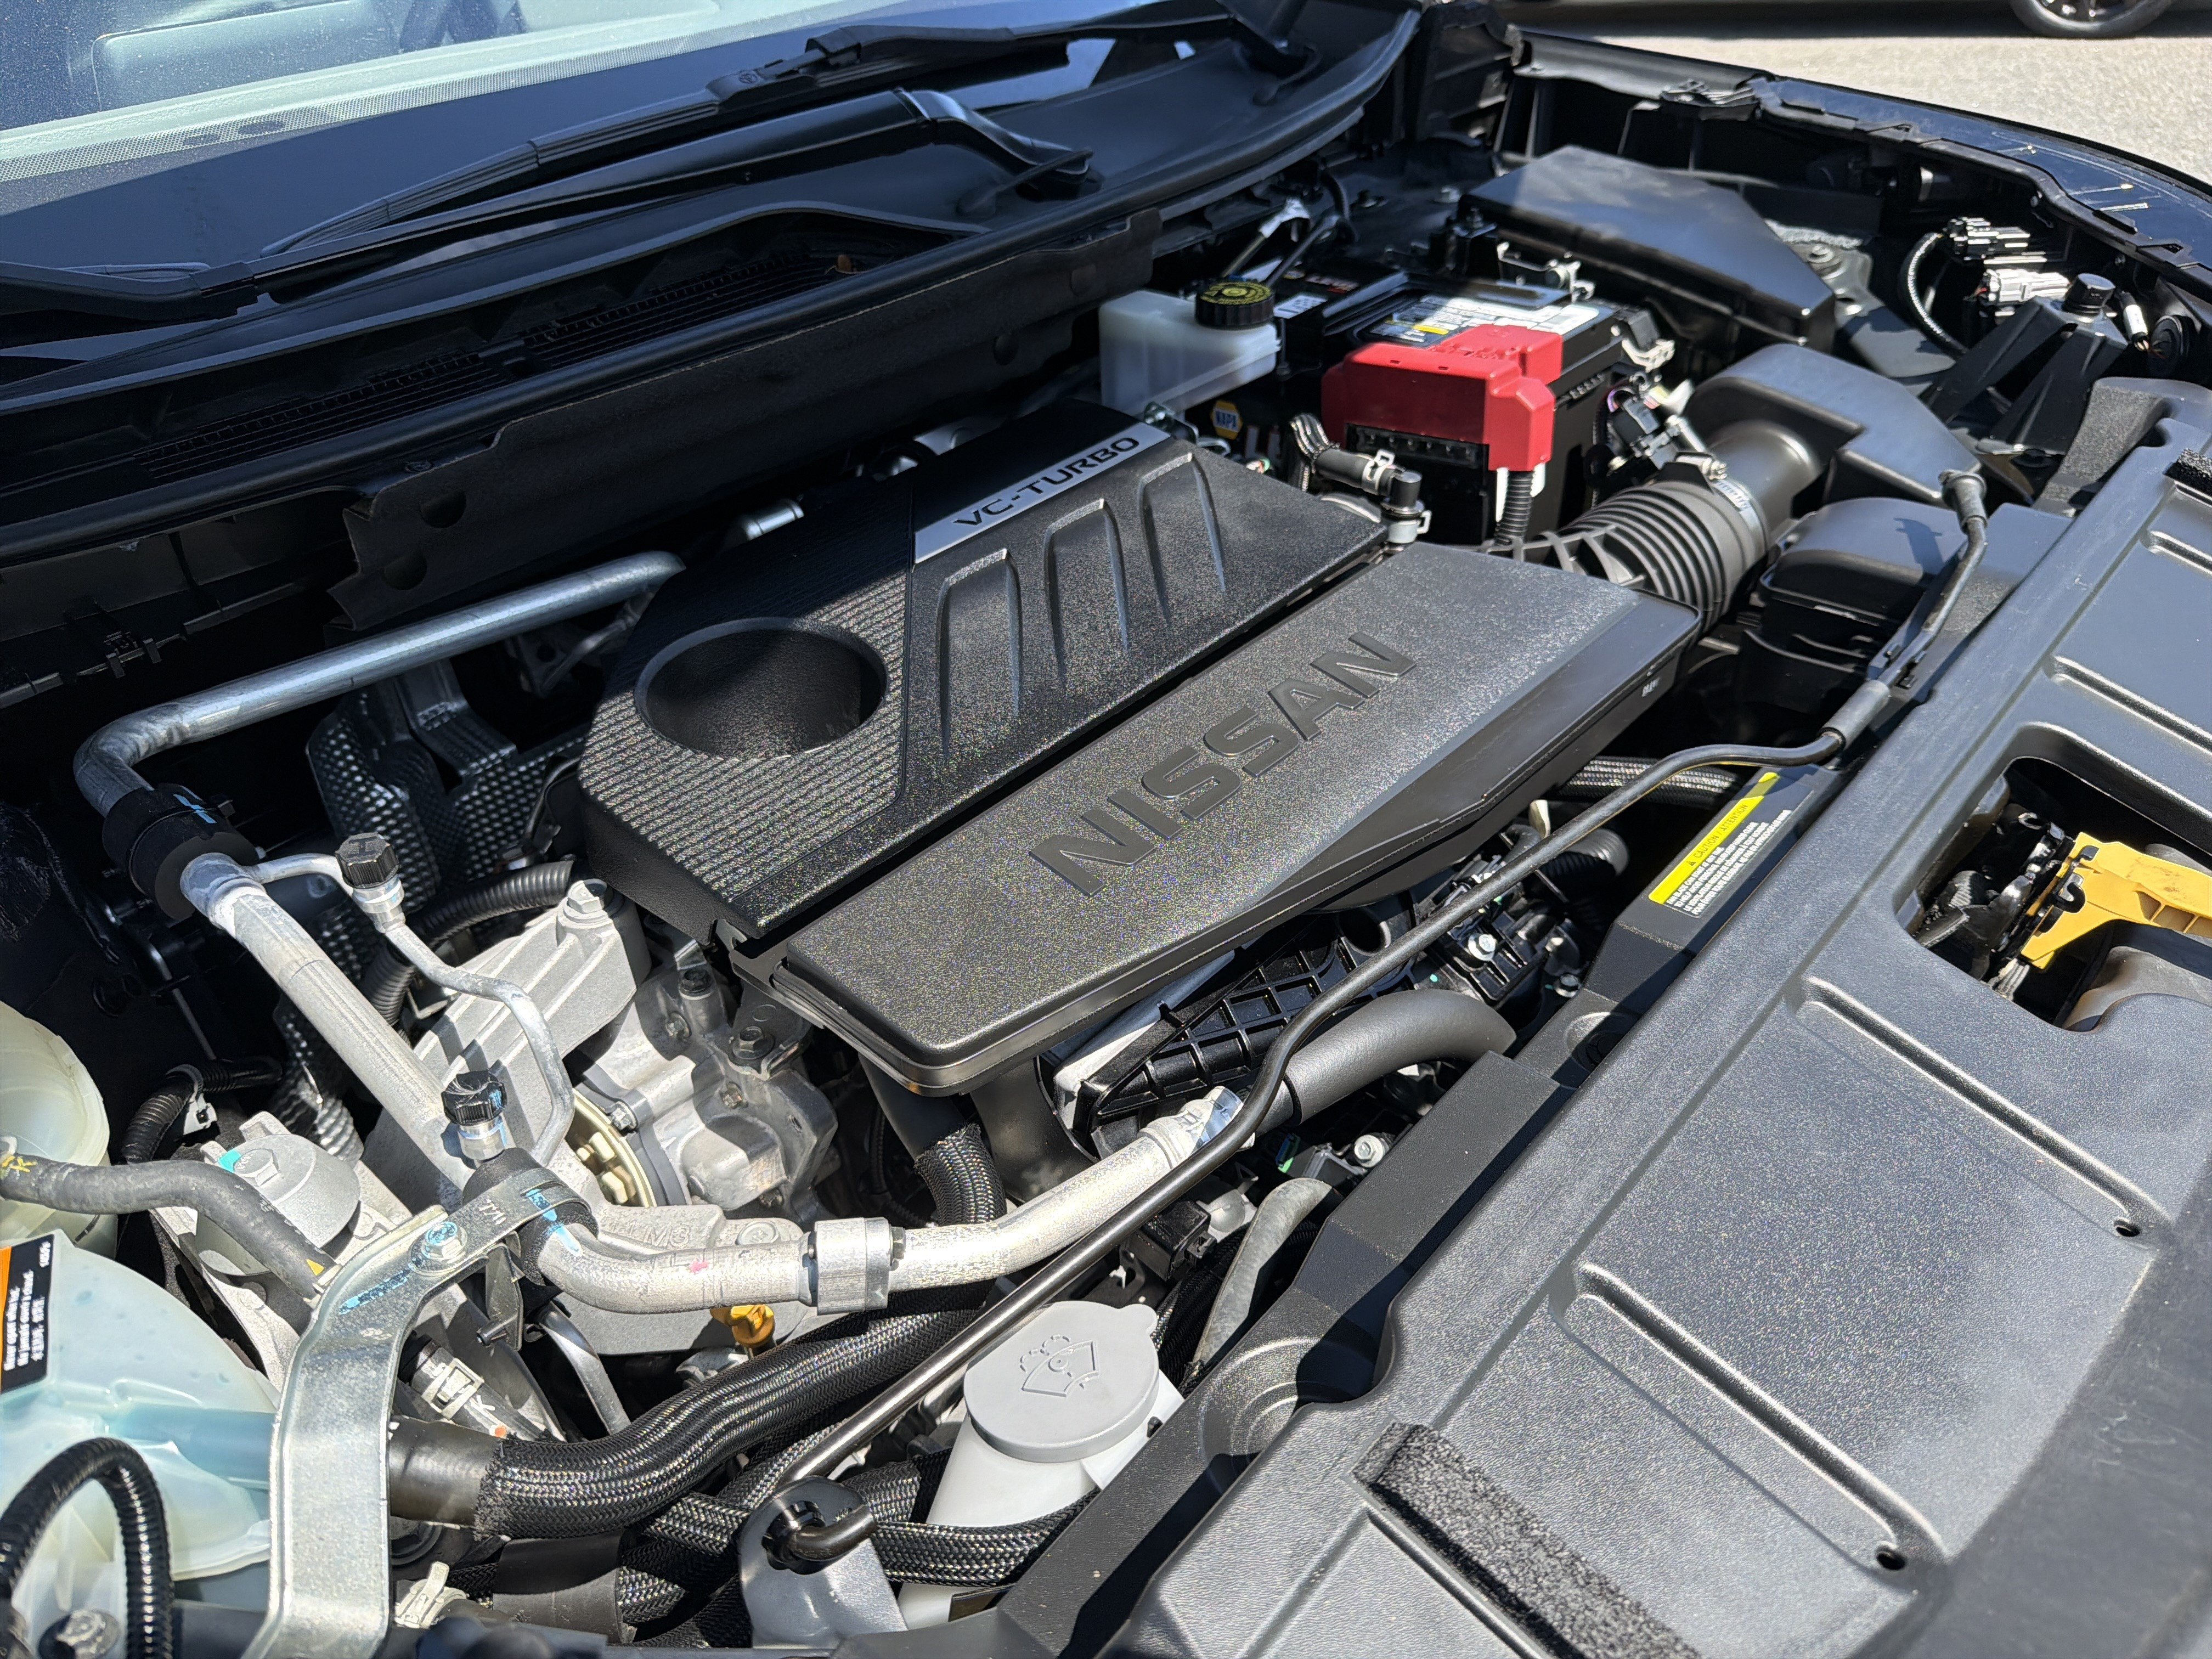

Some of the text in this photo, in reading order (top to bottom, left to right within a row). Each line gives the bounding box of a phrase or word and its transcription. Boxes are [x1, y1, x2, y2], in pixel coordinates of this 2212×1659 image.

[1215, 410, 1238, 431] NAPA
[953, 437, 1139, 526] VC-TURBO
[1029, 632, 1417, 896] NISSAN
[1694, 834, 1719, 859] CAUTION
[1719, 804, 1748, 831] ATTENTION
[1667, 896, 1678, 904] FAN
[1673, 884, 1689, 897] BLADE
[1684, 877, 1696, 885] CAN
[1691, 866, 1705, 878] START
[1706, 855, 1716, 863] ANY
[1679, 891, 1691, 902] HELP
[1689, 881, 1703, 893] AVOID
[1698, 864, 1719, 882] PERSONAL
[1732, 832, 1747, 845] HANDS
[1688, 883, 1712, 906] VENTILATEUR
[1743, 836, 1756, 846] TOUT
[1691, 902, 1706, 915] POUR
[1711, 879, 1727, 892] TOUTE
[7, 1302, 18, 1321] when
[20, 1301, 30, 1323] ouvrir
[7, 1322, 17, 1344] open
[19, 1323, 30, 1352] jamais
[4, 1345, 16, 1370] Never
[17, 1352, 29, 1366] Ne
